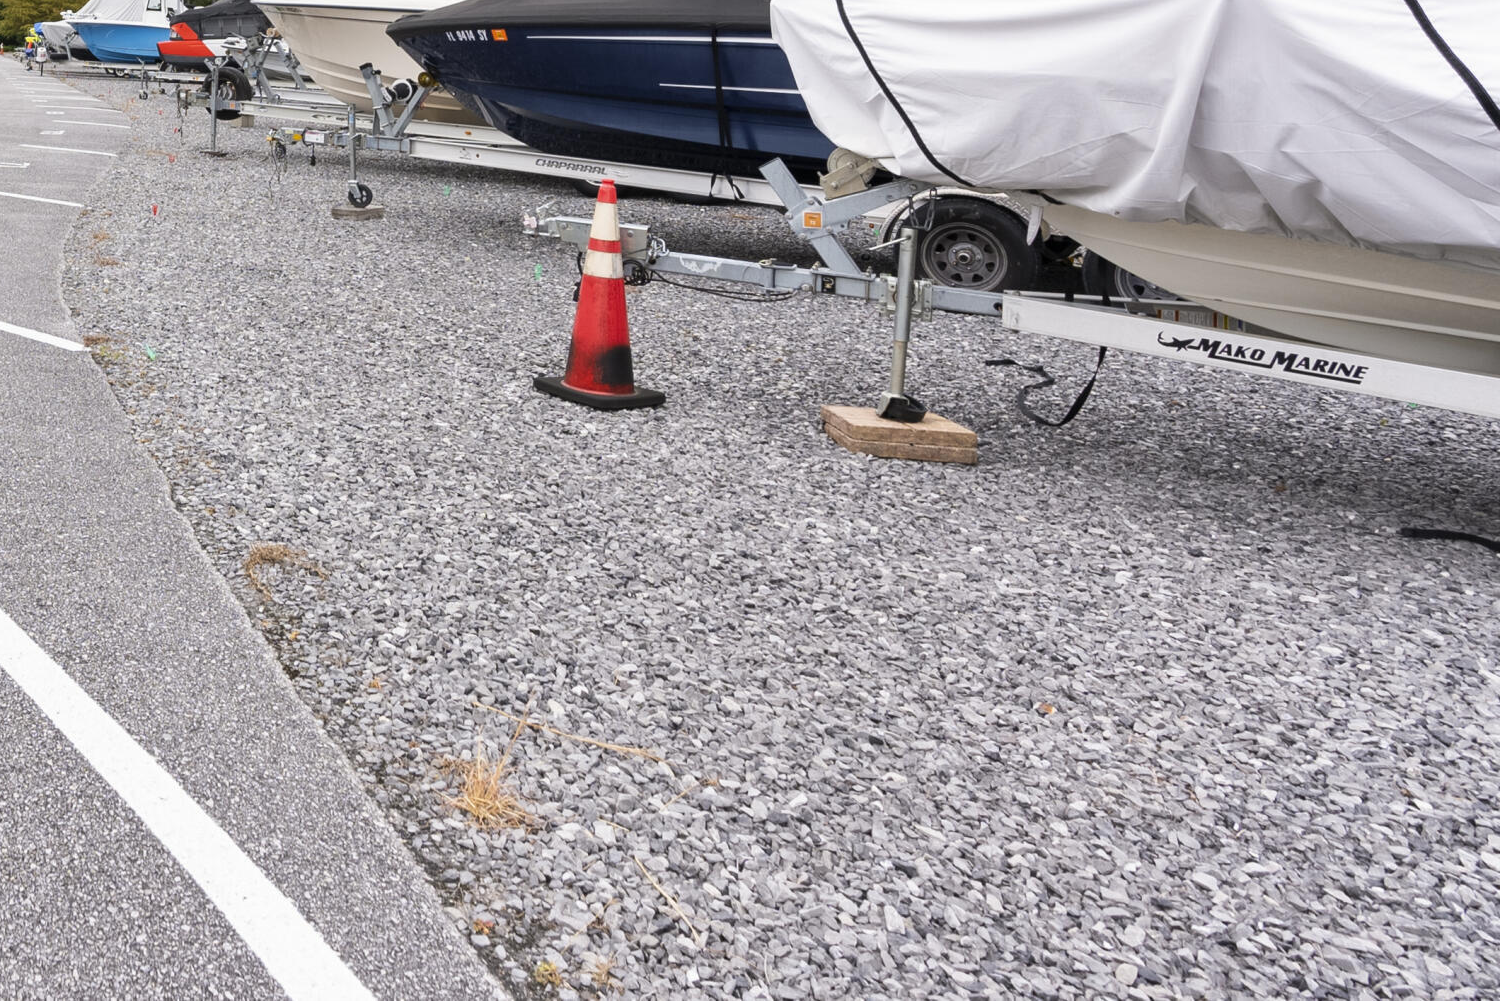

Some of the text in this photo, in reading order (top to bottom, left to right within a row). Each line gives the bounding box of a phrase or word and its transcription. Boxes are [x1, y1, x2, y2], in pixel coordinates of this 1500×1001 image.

[535, 158, 608, 175] CHAPARRAL
[1198, 338, 1369, 382] MAKO MARINE
